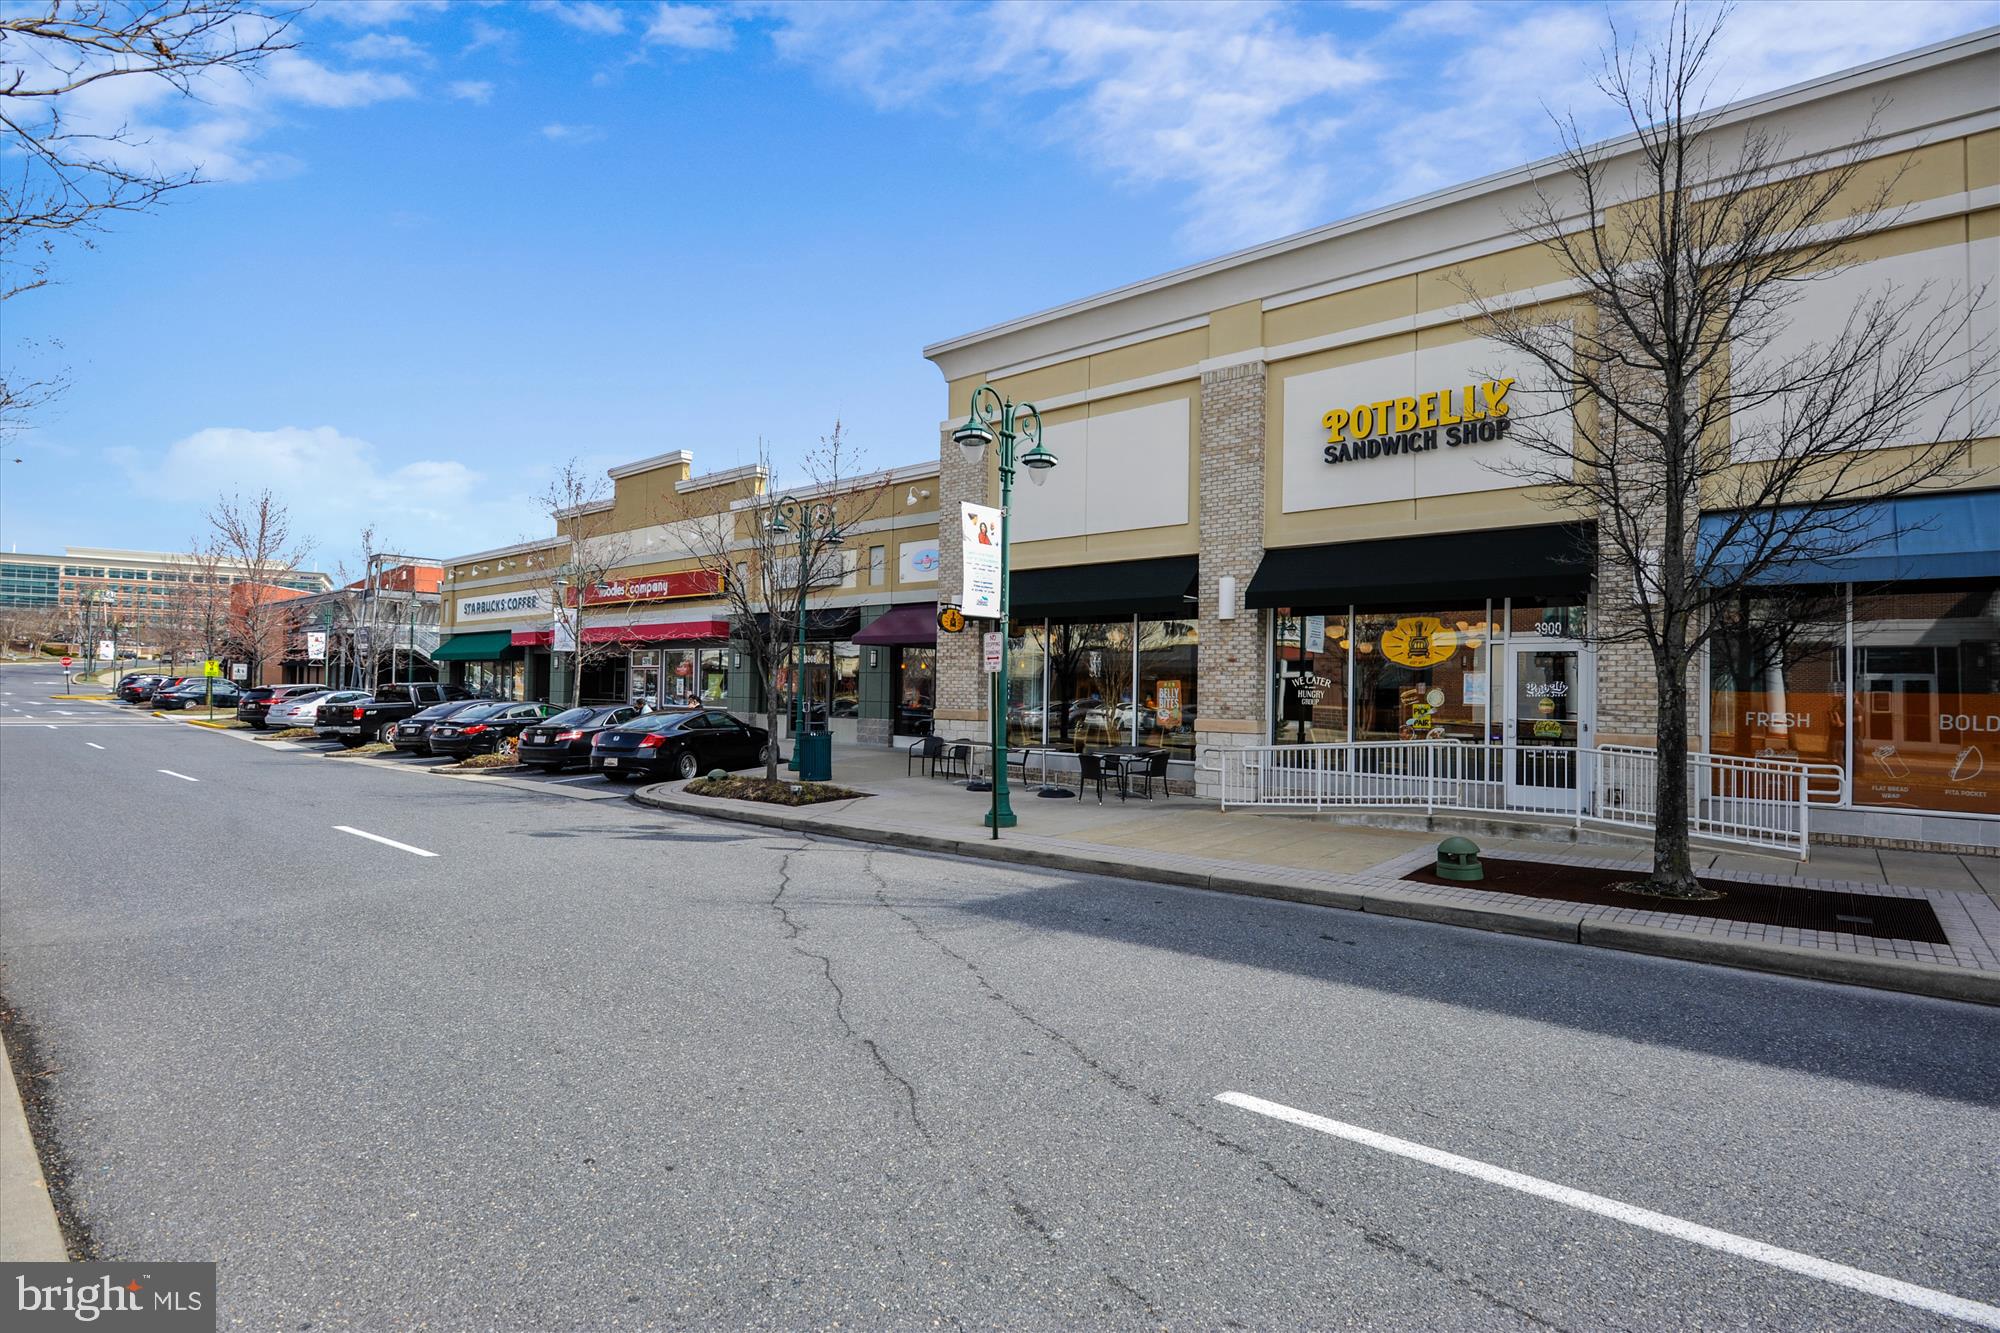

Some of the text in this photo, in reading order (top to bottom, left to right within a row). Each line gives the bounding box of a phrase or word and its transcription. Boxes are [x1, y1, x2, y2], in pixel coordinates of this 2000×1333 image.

[1322, 378, 1515, 444] POTBELLY
[1324, 418, 1511, 465] SANDWICH SHOP
[630, 580, 668, 597] company
[464, 595, 539, 616] STARBUCKS COFFEE
[1534, 621, 1562, 636] 3900
[1292, 676, 1332, 688] WE CATER
[1159, 687, 1179, 699] BELLY
[1297, 689, 1325, 699] HUNGRY
[1159, 698, 1179, 709] BITES
[1301, 698, 1320, 706] GROUP
[1745, 711, 1811, 729] FRESH
[1939, 713, 2000, 733] BOLD
[1960, 790, 1988, 798] POCKET
